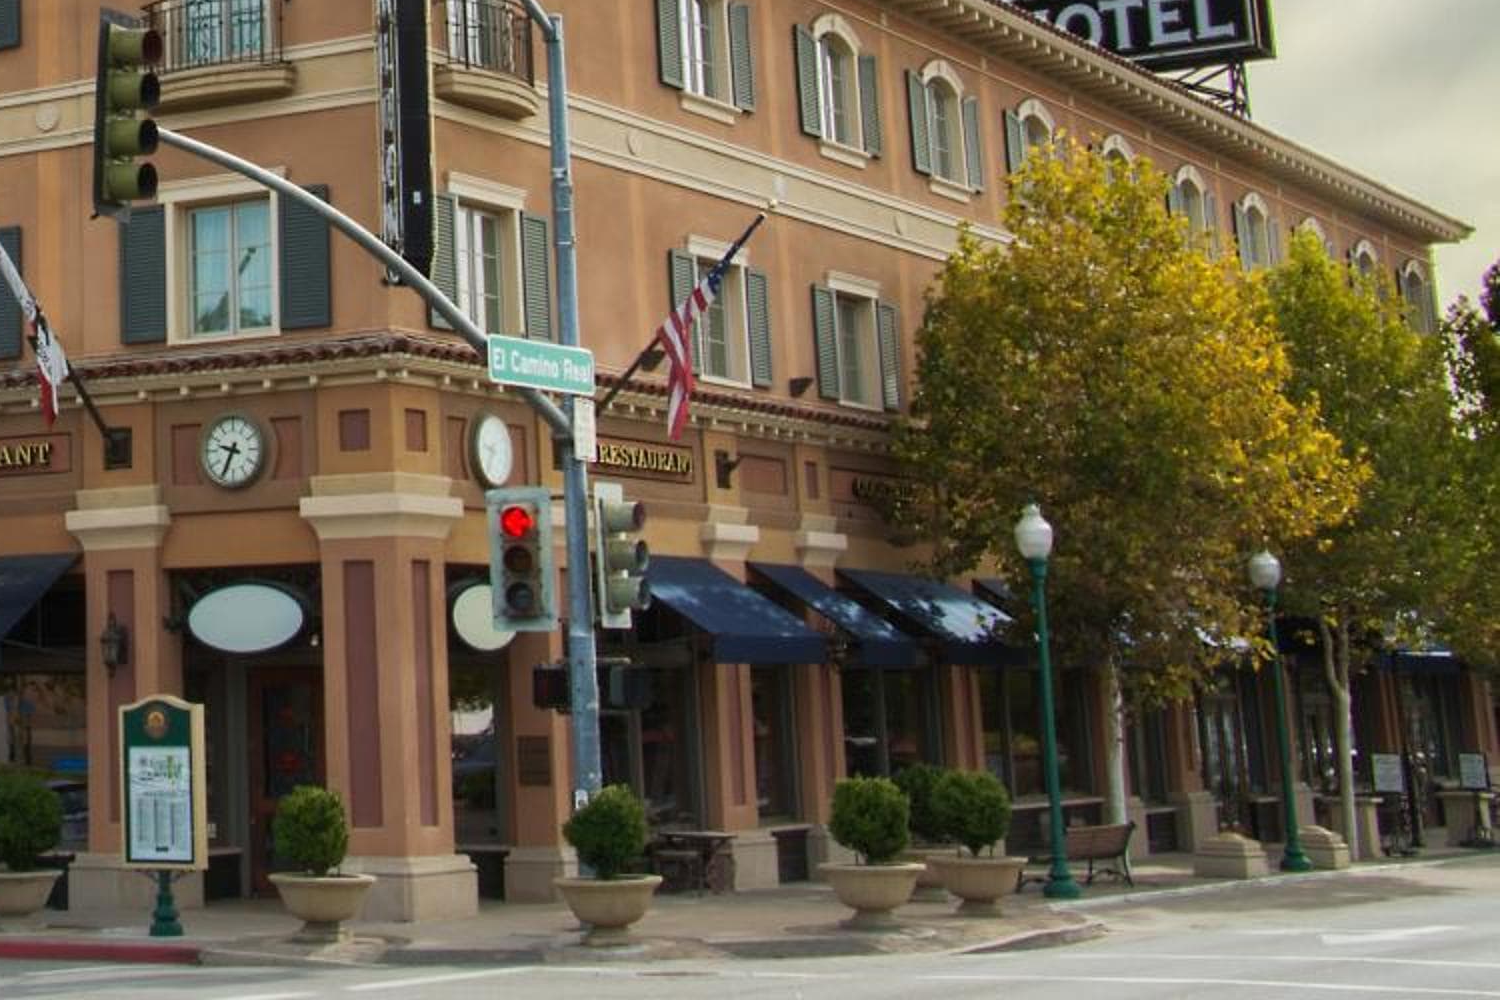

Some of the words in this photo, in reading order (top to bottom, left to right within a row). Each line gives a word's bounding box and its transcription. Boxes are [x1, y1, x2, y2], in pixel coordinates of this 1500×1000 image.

[493, 347, 504, 371] El
[511, 349, 558, 379] Camino
[563, 358, 590, 382] Real
